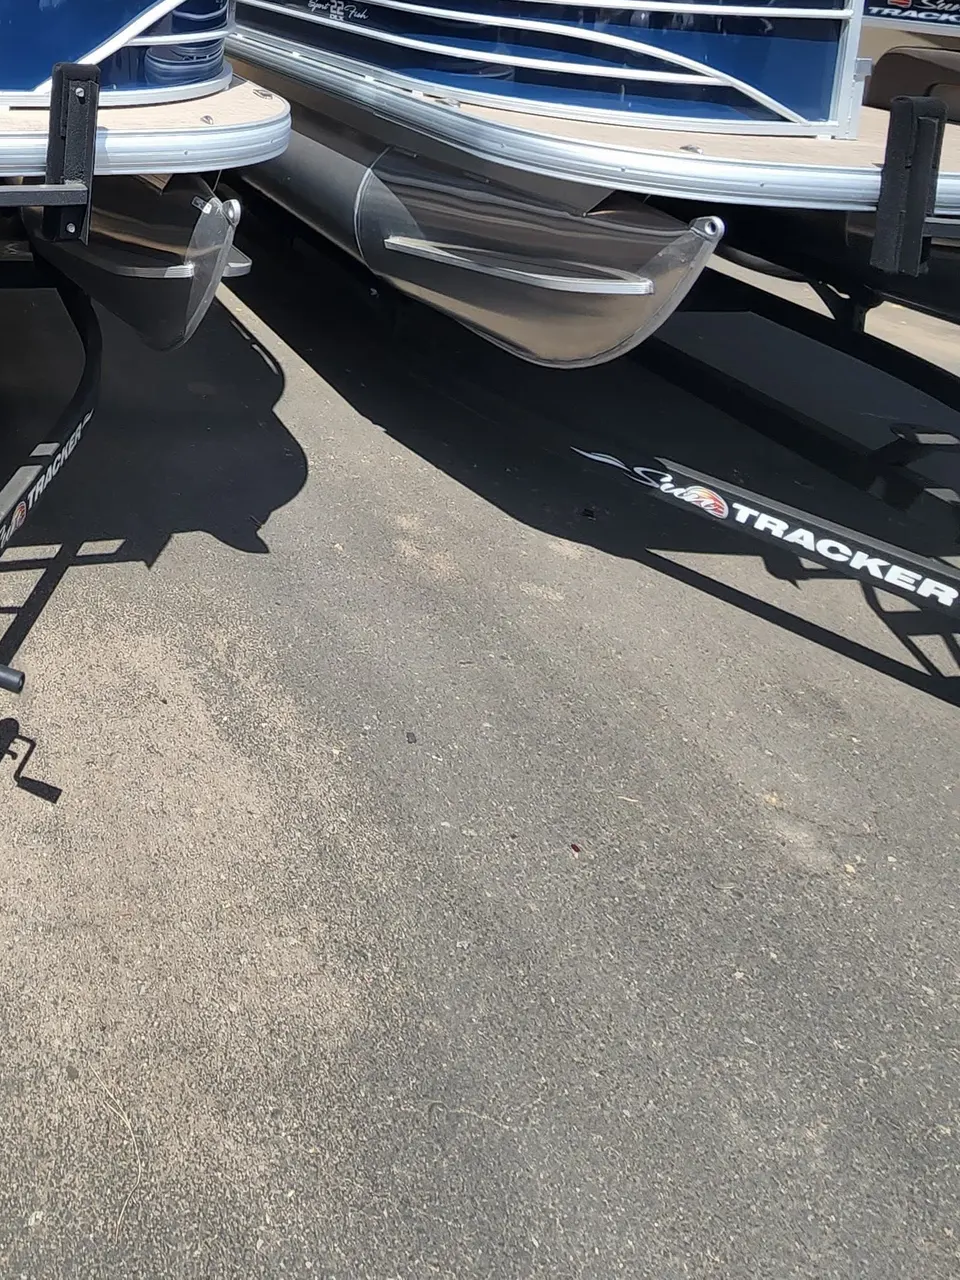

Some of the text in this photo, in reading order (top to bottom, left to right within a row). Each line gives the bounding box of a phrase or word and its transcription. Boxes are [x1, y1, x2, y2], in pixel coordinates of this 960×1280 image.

[329, 0, 345, 15] 22
[344, 4, 368, 19] Fish
[27, 422, 82, 510] TRACKER
[624, 466, 960, 607] Sun TRACKER
